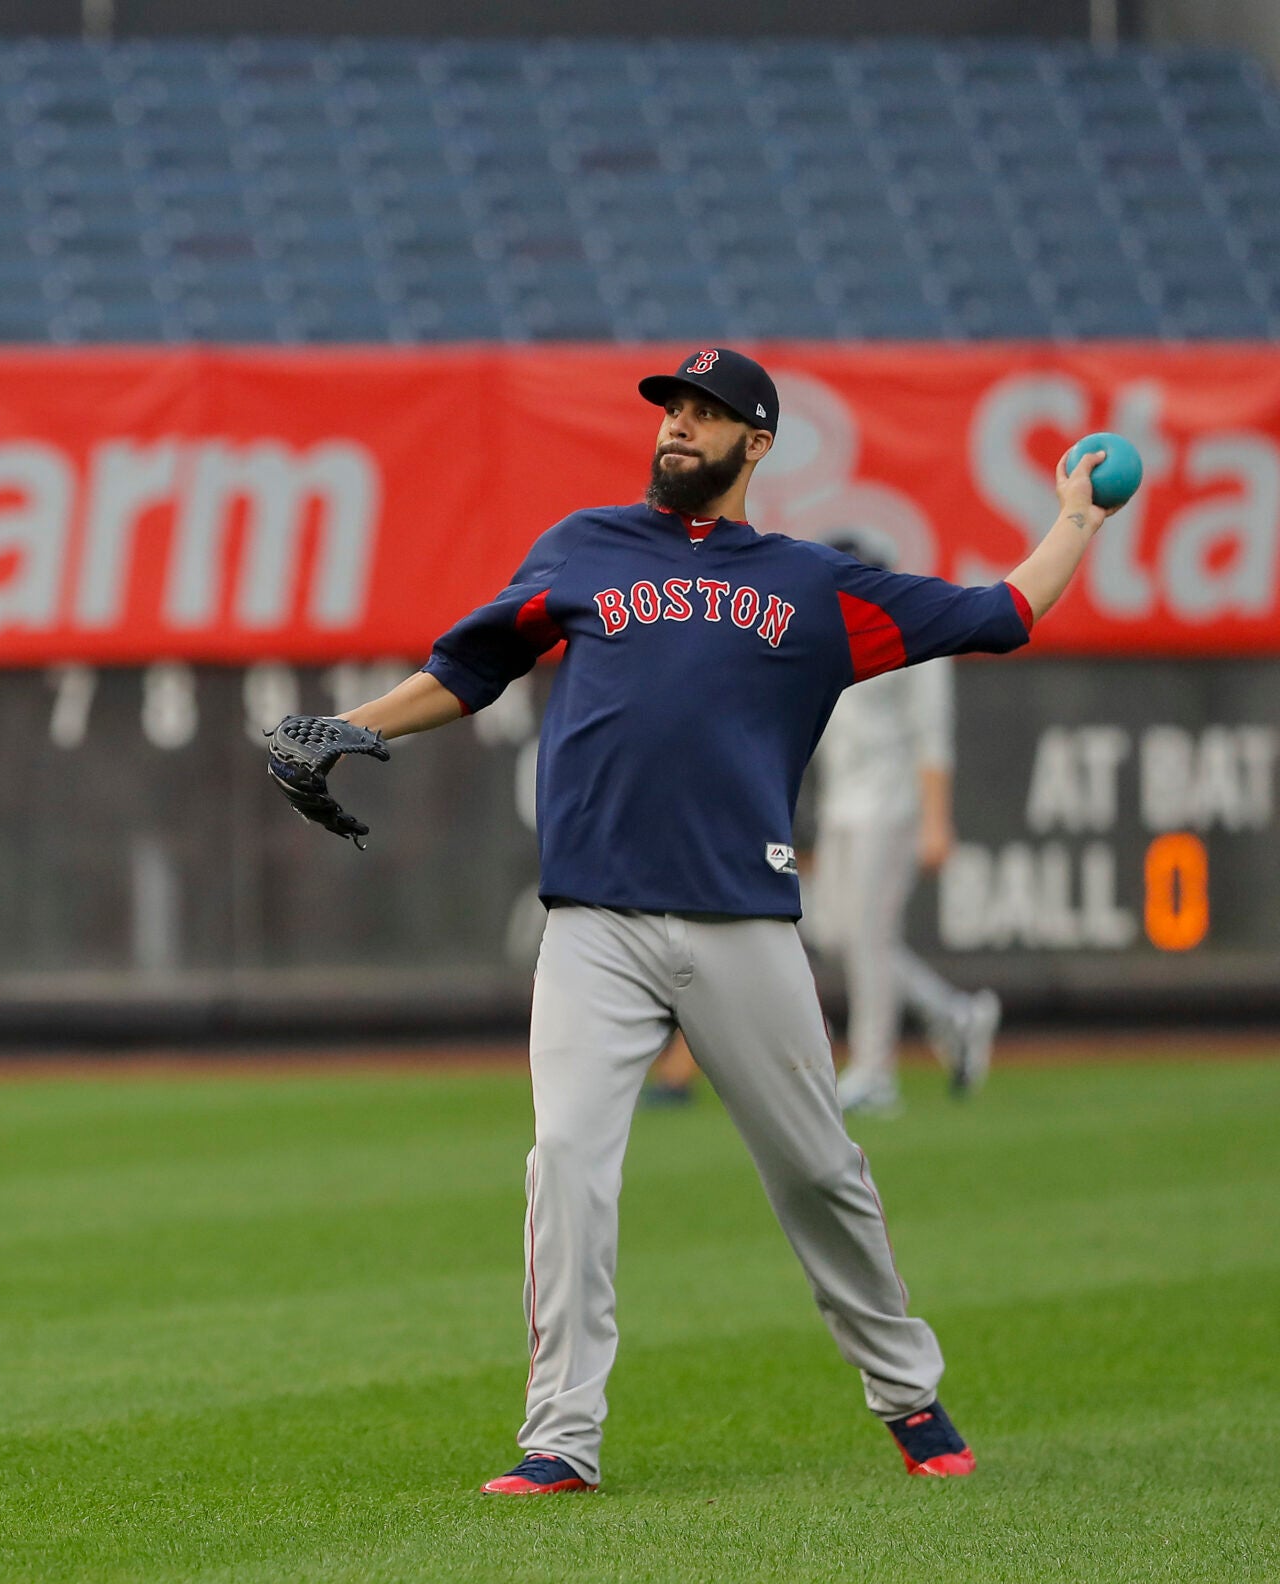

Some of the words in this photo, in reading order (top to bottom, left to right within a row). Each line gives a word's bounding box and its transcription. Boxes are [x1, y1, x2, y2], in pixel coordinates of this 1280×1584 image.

[686, 349, 720, 374] B
[593, 577, 796, 648] BOSTON
[49, 670, 95, 749] 7
[1026, 726, 1131, 832] AT
[1140, 724, 1278, 832] BAT
[937, 841, 1135, 950] BALL
[1144, 832, 1209, 951] 0
